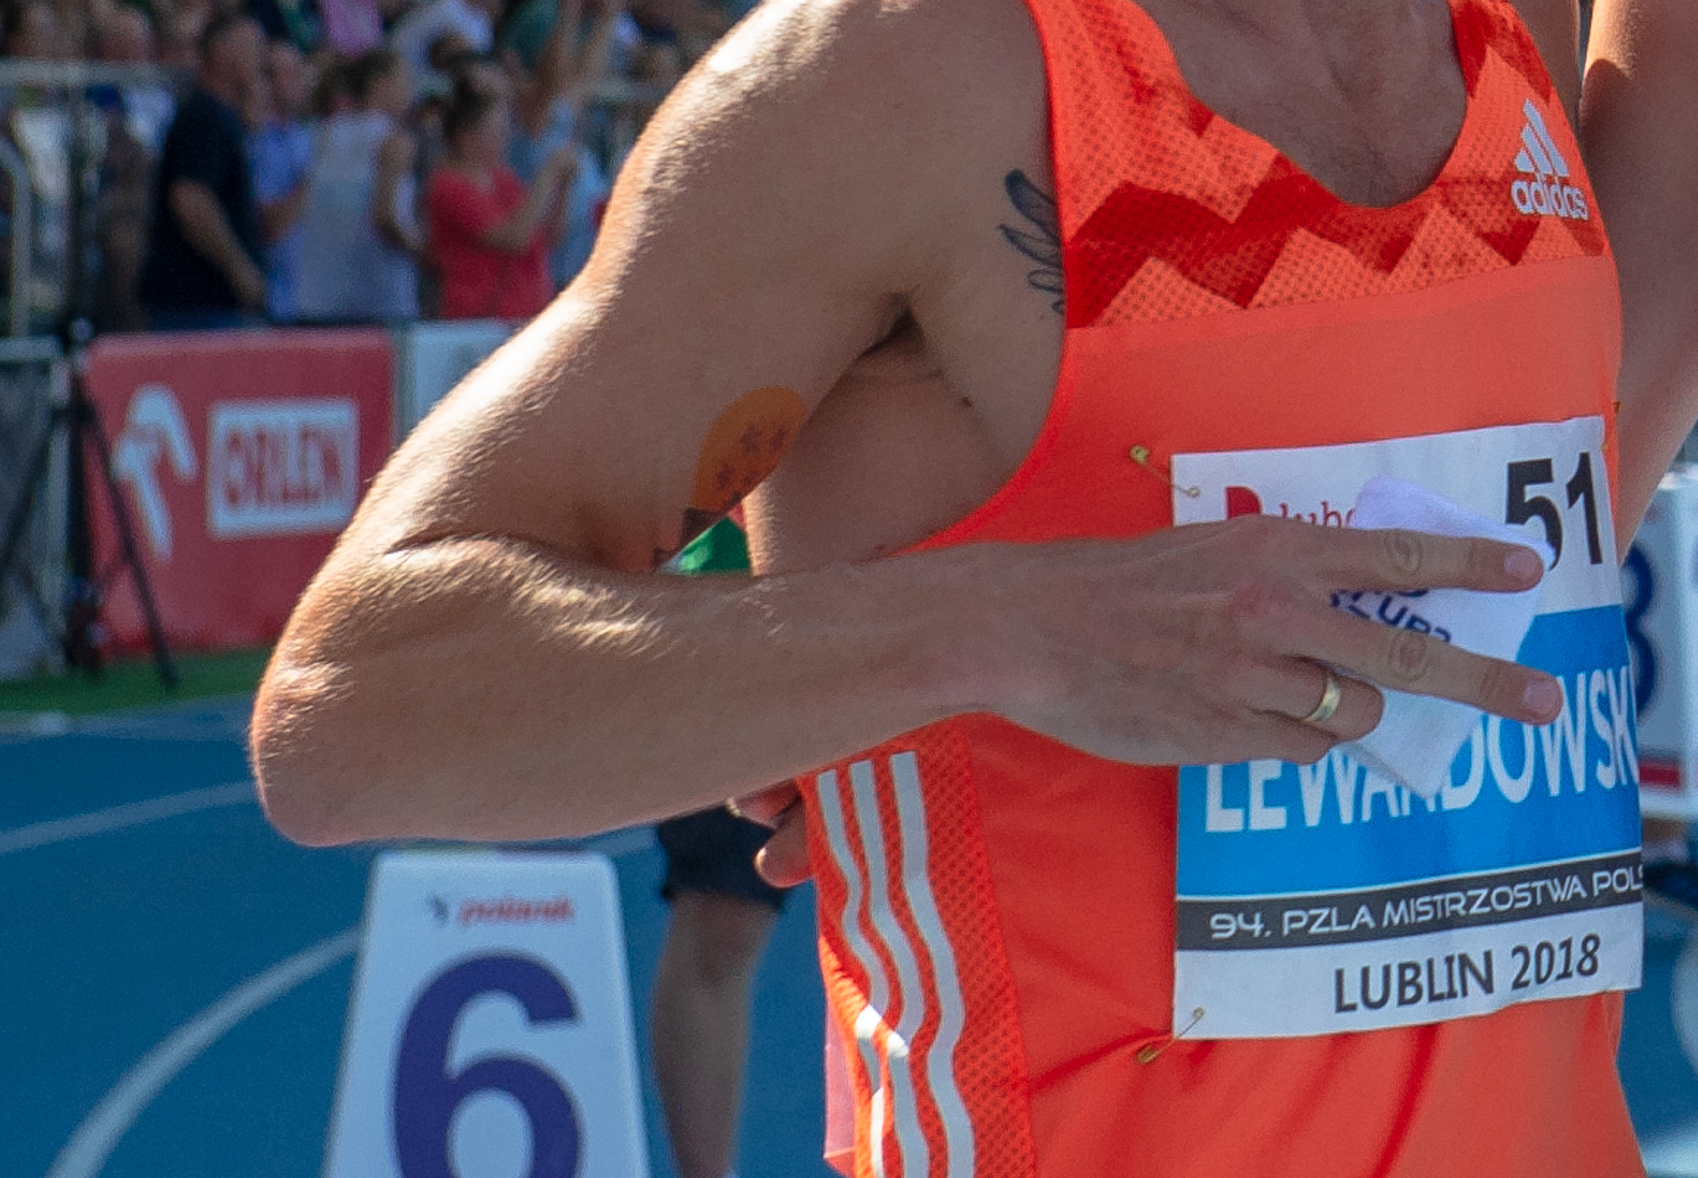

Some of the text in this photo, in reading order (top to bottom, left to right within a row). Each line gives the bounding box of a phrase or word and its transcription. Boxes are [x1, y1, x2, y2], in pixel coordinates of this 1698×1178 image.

[1511, 172, 1589, 220] adidas
[222, 427, 343, 510] ORLEN
[1505, 452, 1603, 571] 51
[1204, 665, 1640, 833] LEWDOWSK
[1209, 911, 1272, 940] 94.
[1282, 904, 1377, 937] PZLA
[1382, 875, 1588, 928] MISTRZOSTWA
[1335, 933, 1601, 1014] LUBLIN 2018
[388, 947, 584, 1178] 6
